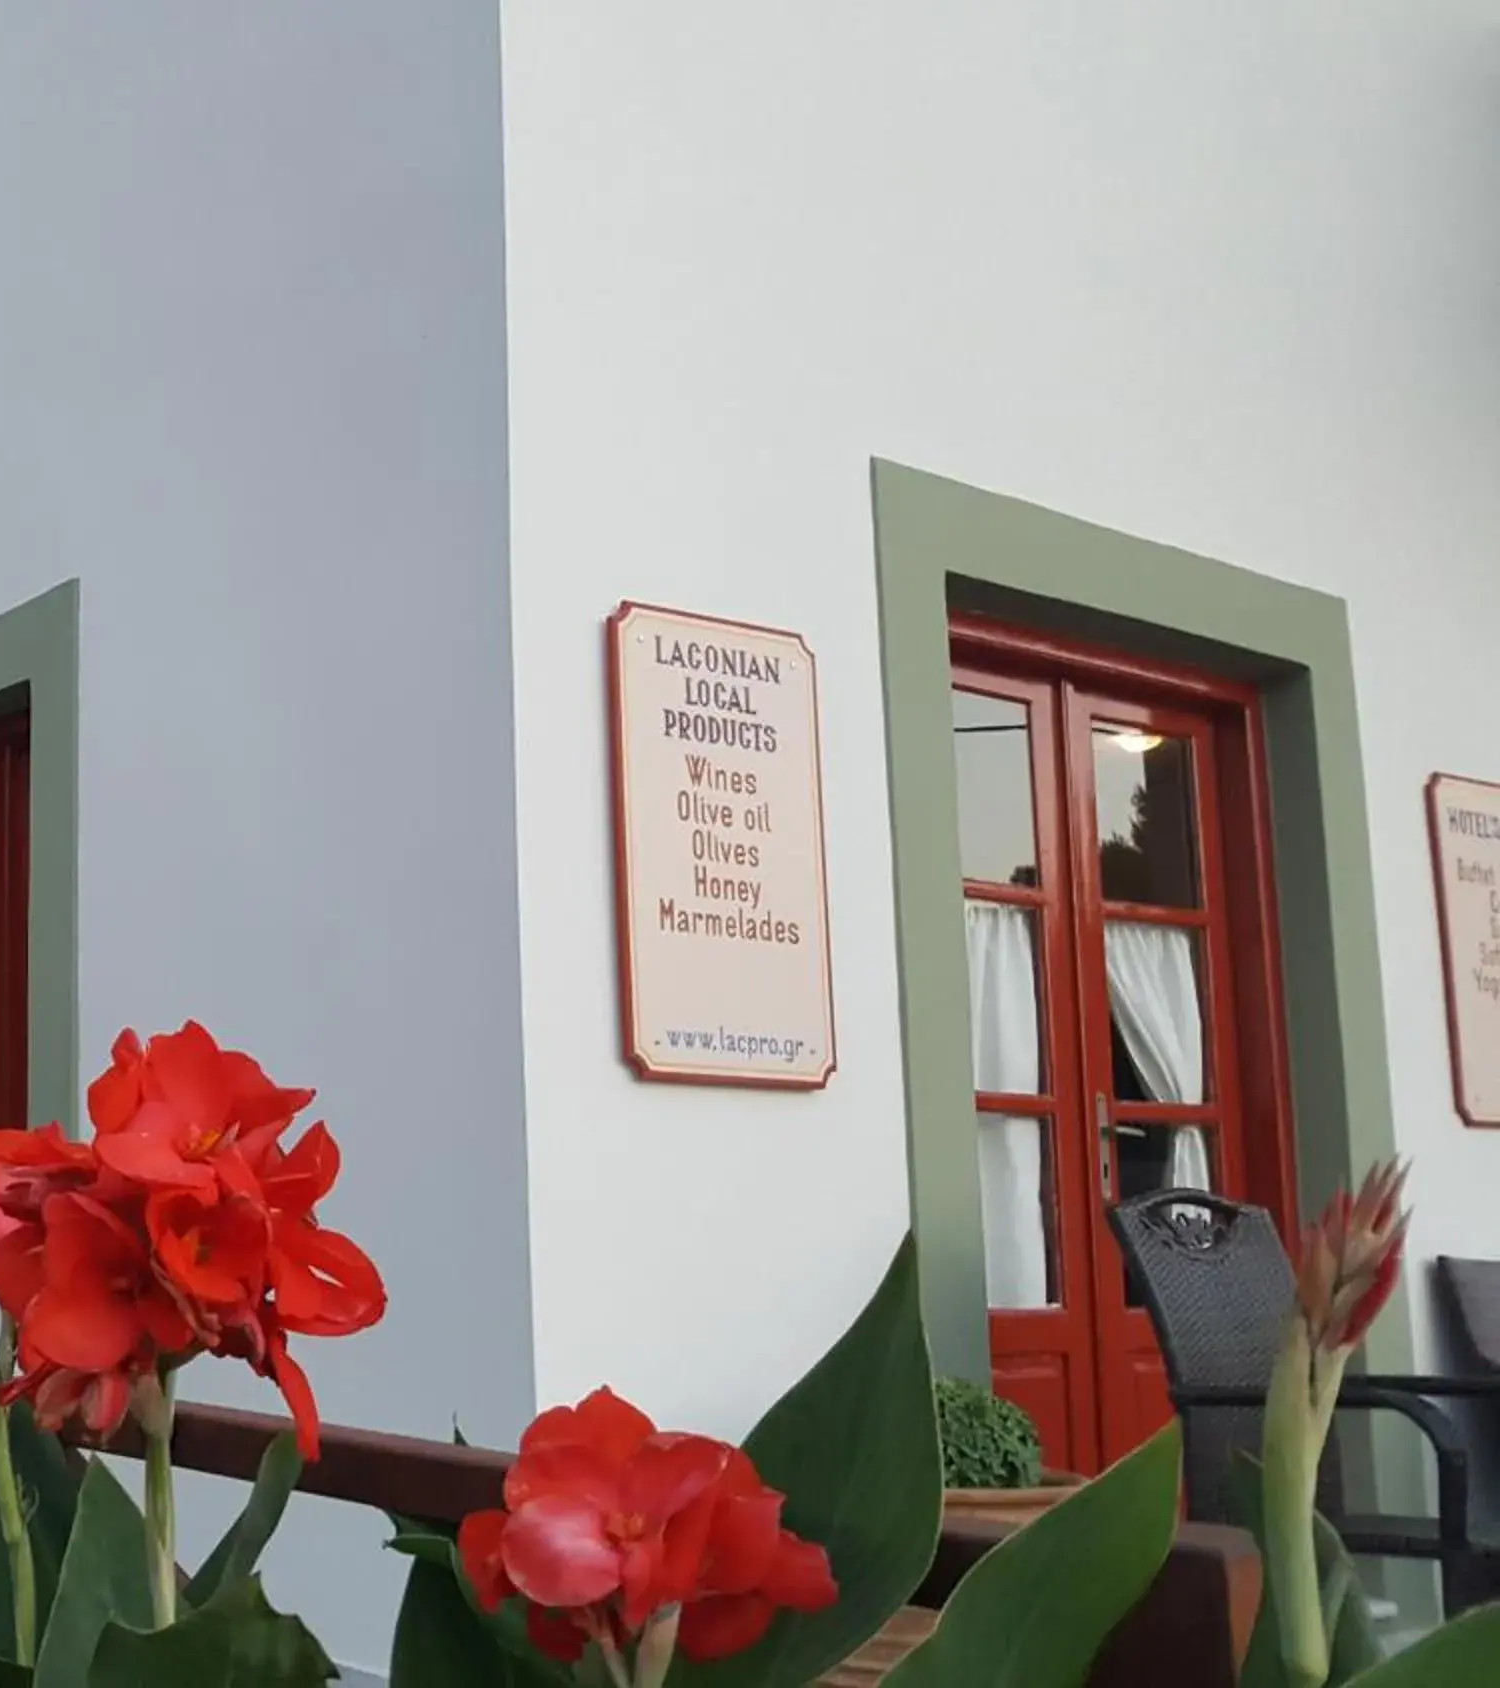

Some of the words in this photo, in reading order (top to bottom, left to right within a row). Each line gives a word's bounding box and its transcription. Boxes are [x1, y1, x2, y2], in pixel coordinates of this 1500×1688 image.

[654, 634, 781, 684] LACONIAN
[685, 676, 757, 715] LOCAL
[663, 708, 778, 753] PRODUCTS
[685, 753, 757, 795] Wines
[677, 790, 733, 828] Olive
[744, 802, 772, 833] oil
[691, 829, 759, 868] Olives
[694, 865, 762, 909] Honey
[659, 897, 801, 945] Marmelades
[666, 1026, 804, 1062] www.lacpro.gr
